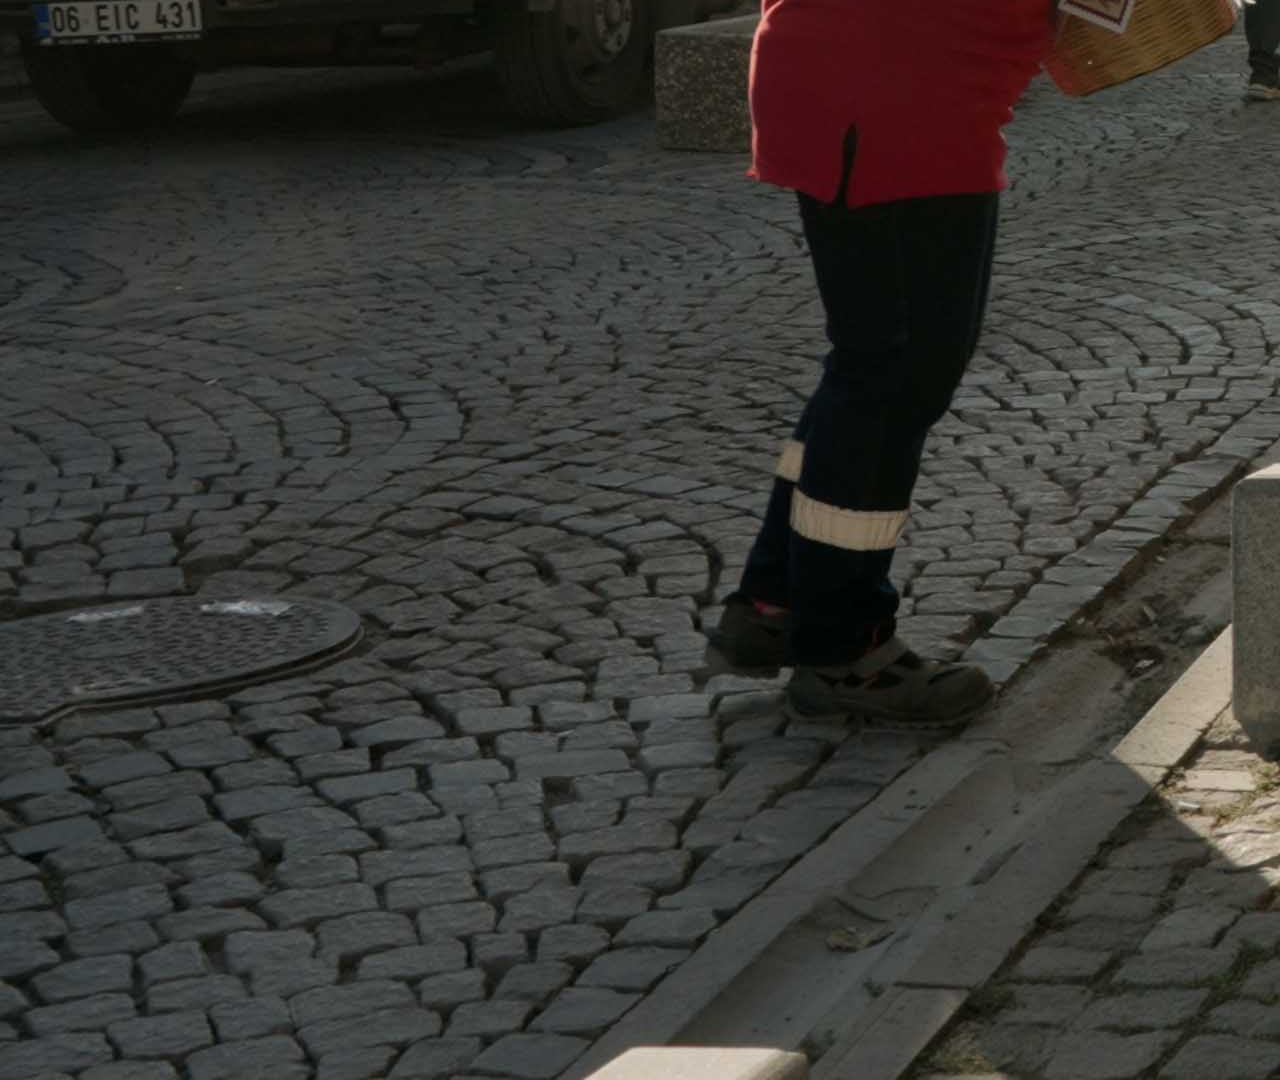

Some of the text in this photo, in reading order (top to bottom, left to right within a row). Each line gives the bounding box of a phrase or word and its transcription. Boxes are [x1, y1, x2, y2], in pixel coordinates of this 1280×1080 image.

[52, 1, 197, 32] 06 EIC 431
